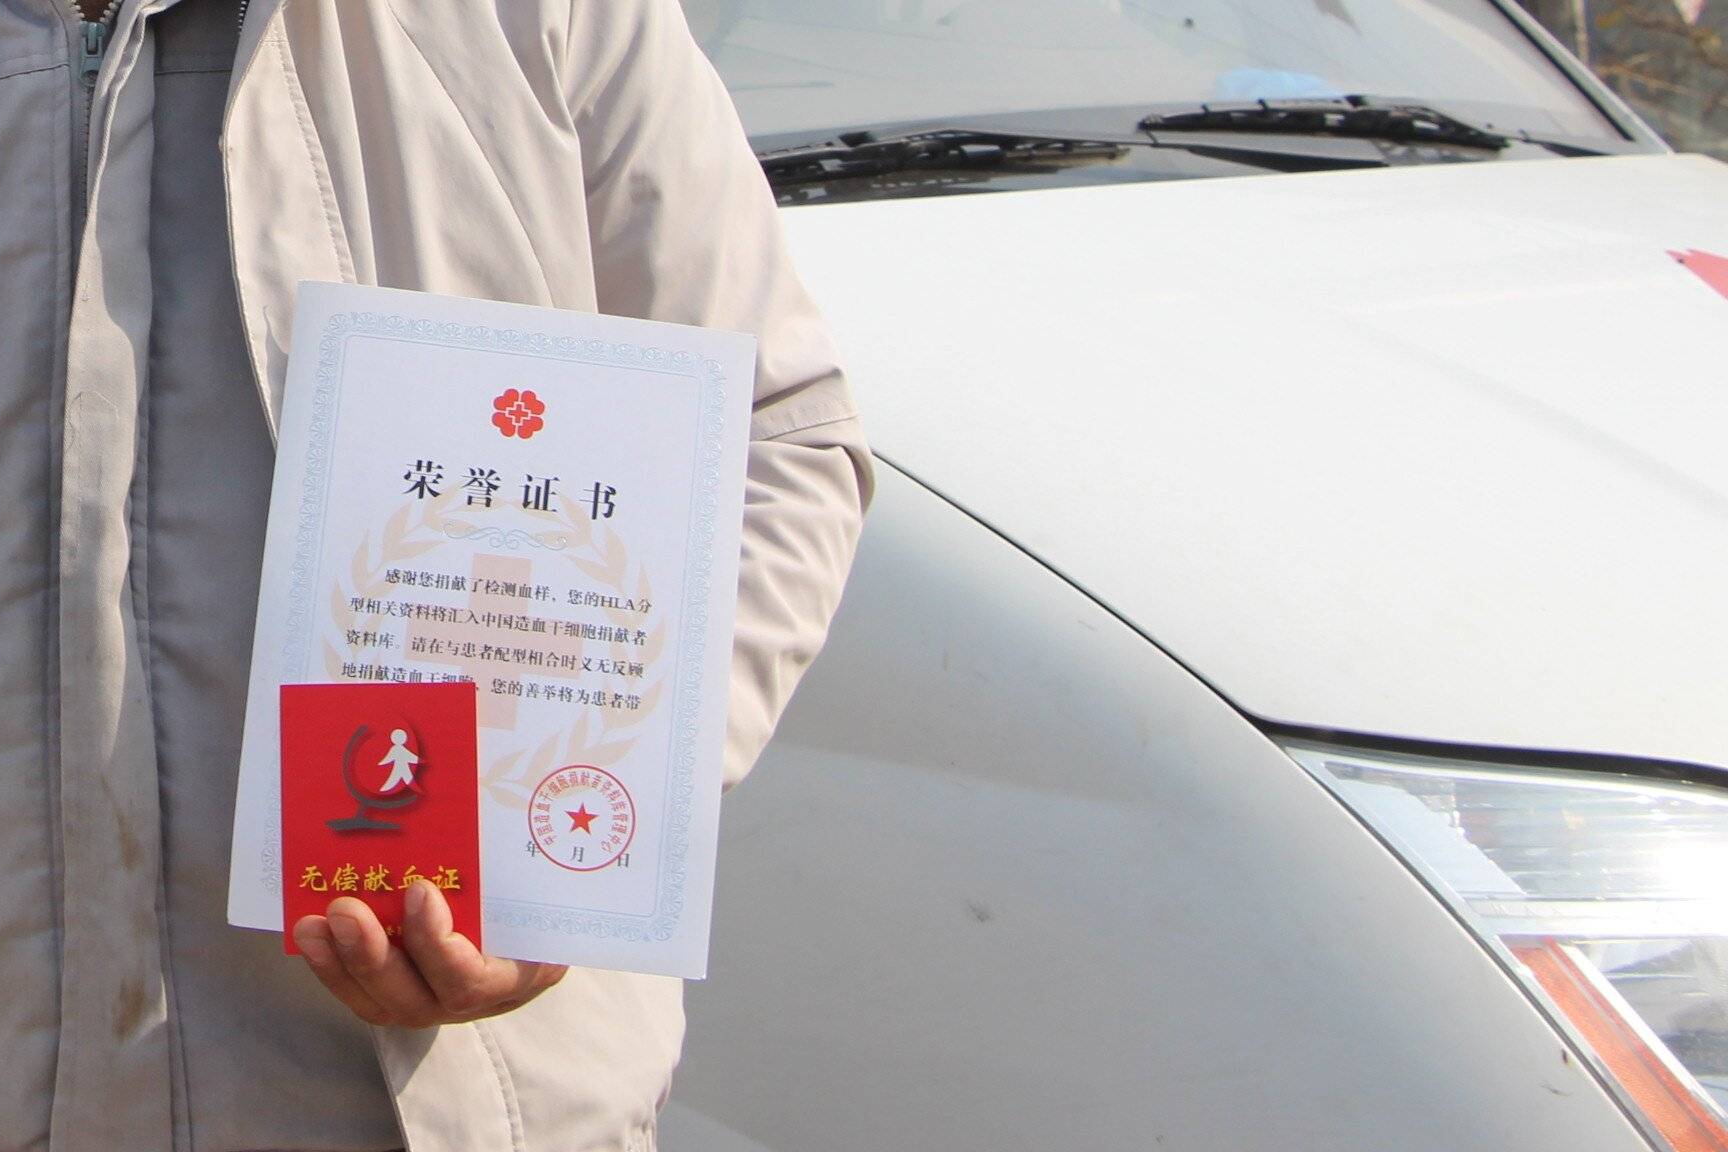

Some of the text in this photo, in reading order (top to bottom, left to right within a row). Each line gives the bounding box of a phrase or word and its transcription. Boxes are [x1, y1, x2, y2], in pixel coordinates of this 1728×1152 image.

[401, 459, 620, 520] 荣誉证书
[350, 597, 648, 647] 型相关资料将汇入中国造血干细胞捐献者
[345, 629, 645, 679] 资料库。请在与患者配型相合时义无反顾
[299, 862, 462, 892] 无偿献血证
[525, 840, 630, 868] 年 月 日
